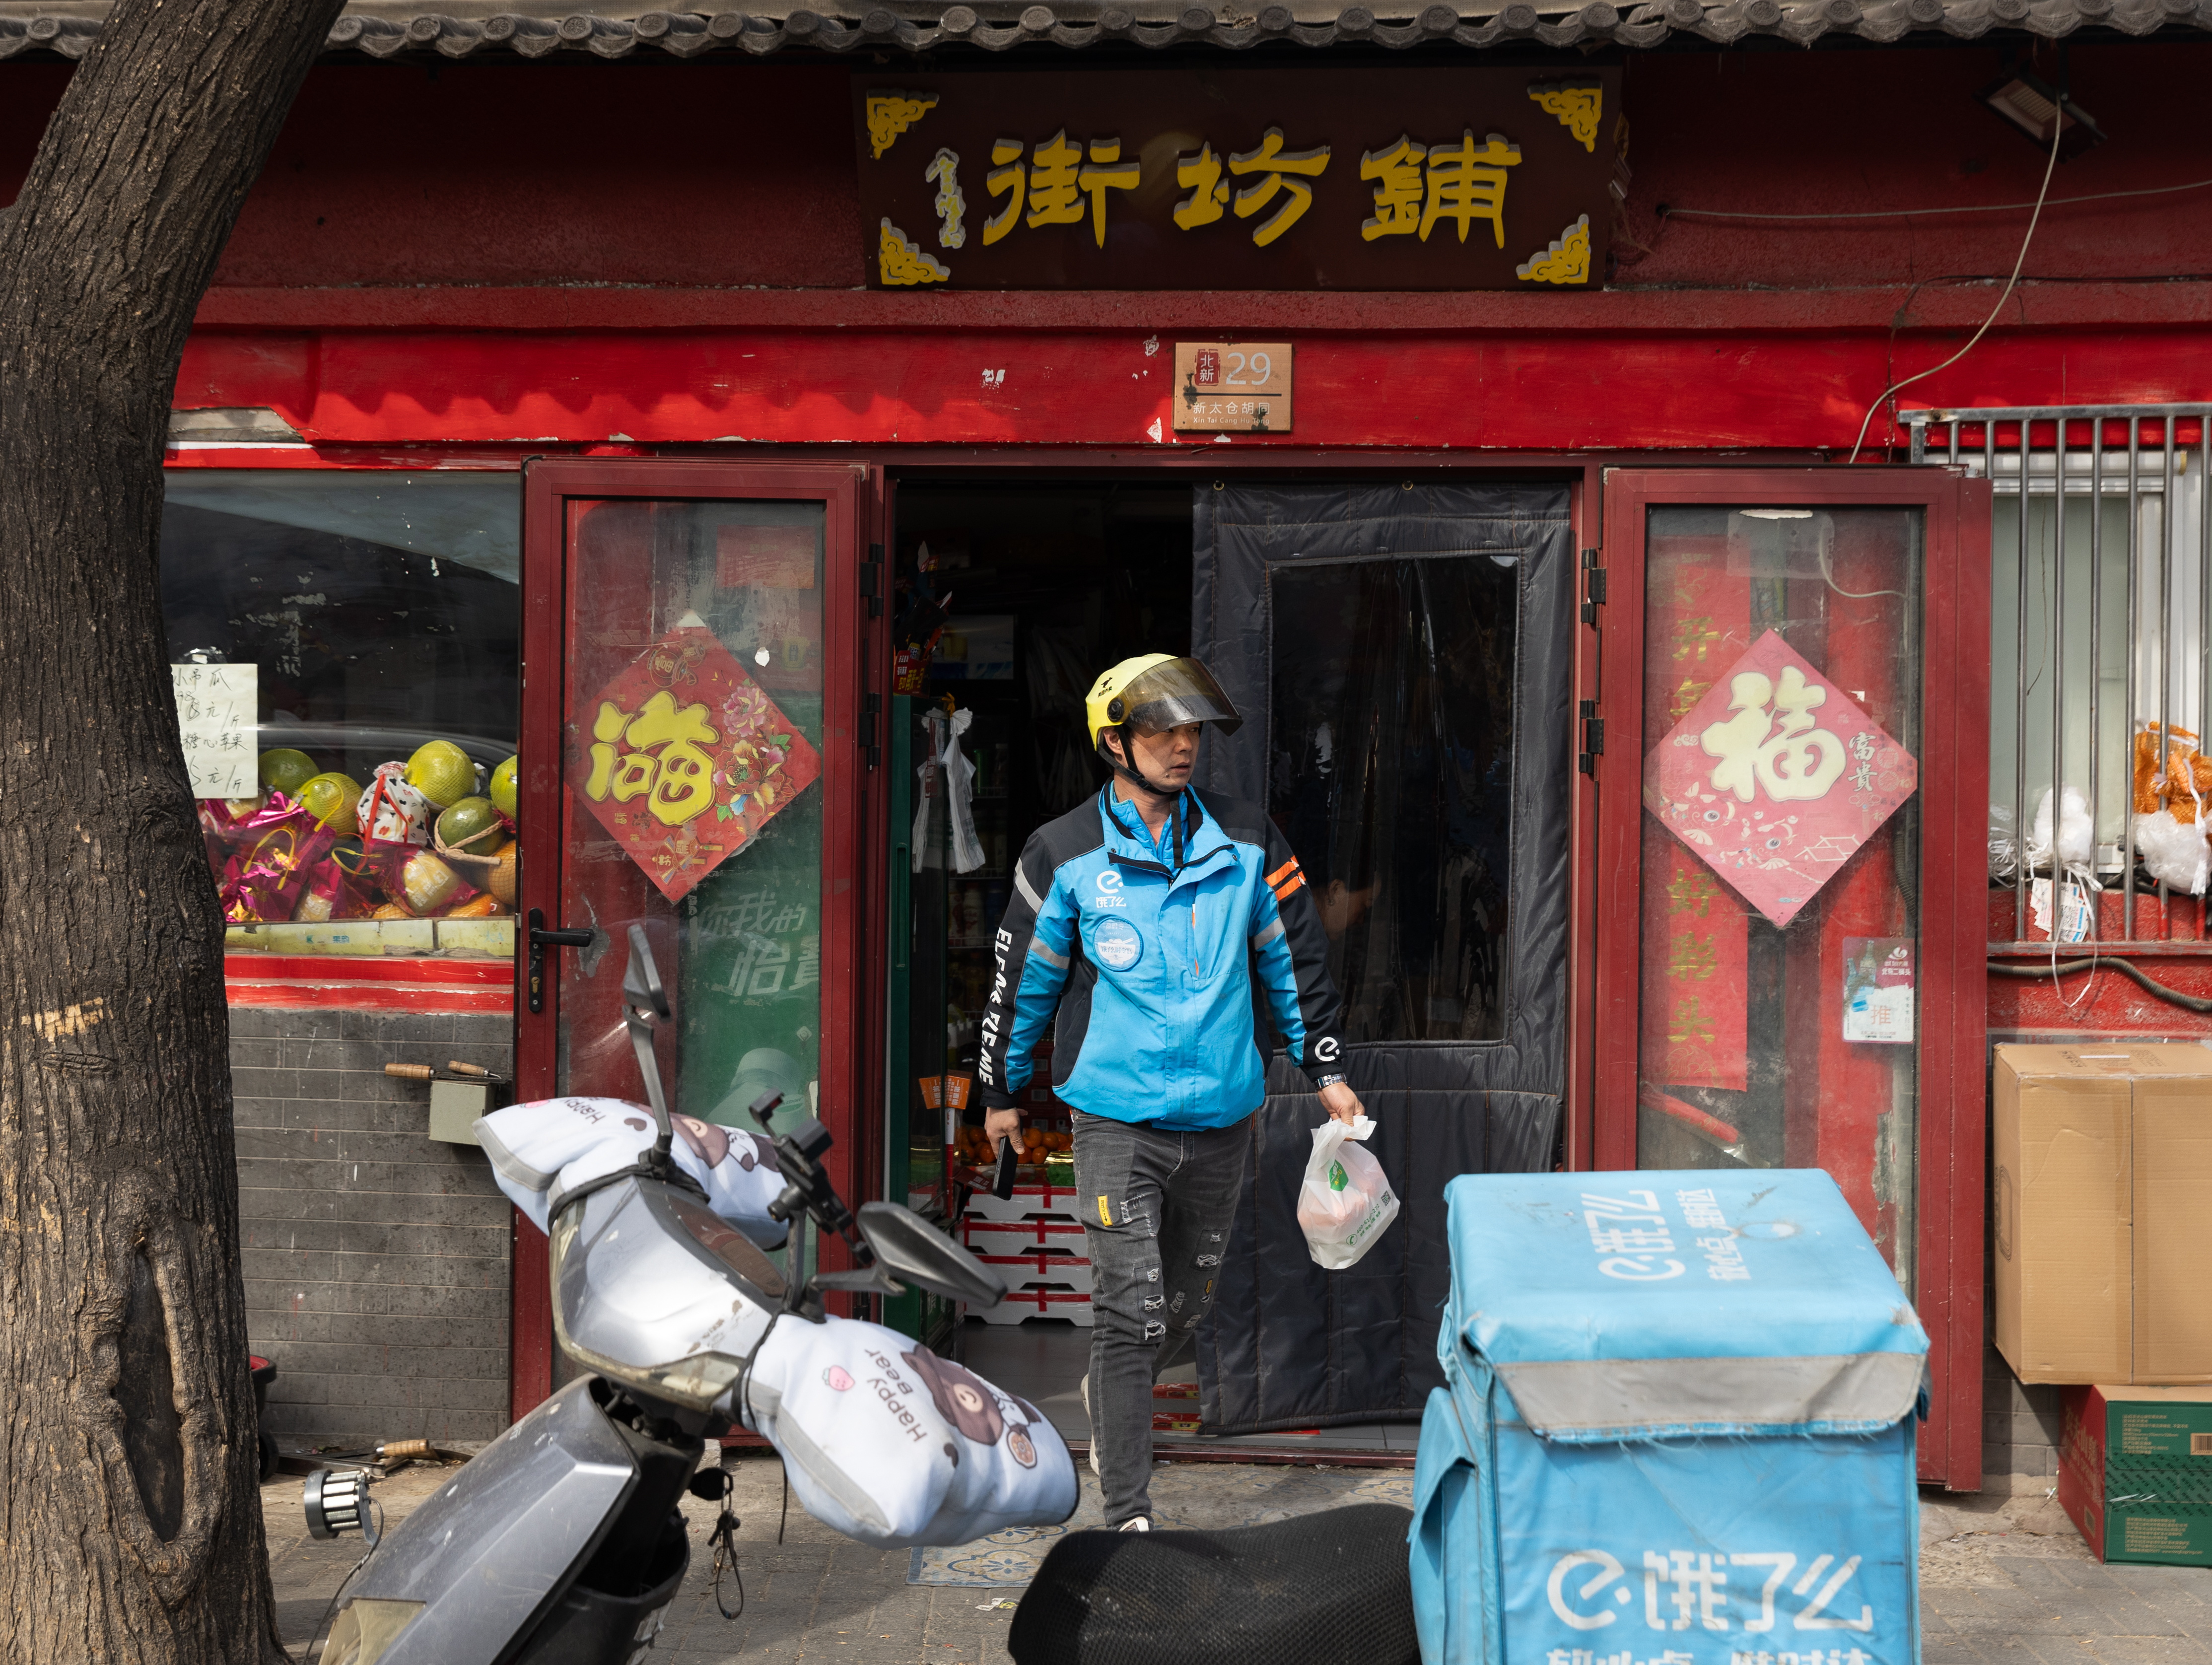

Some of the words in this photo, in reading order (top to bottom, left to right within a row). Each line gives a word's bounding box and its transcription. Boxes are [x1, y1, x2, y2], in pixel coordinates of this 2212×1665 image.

[1200, 354, 1214, 382] 北新
[1226, 352, 1271, 385] 29
[1193, 402, 1270, 415] 新太仓胡同
[1700, 666, 1847, 803] 福
[1847, 731, 1878, 792] 富貴
[1096, 896, 1126, 908] 饿了么
[1665, 869, 1722, 1043] 好彩头
[1871, 1005, 1891, 1025] 推
[1580, 1189, 1676, 1253] 饿了么
[864, 1349, 913, 1394] Bear
[867, 1377, 927, 1442] Happy
[1643, 1550, 1873, 1632] 饿了么
